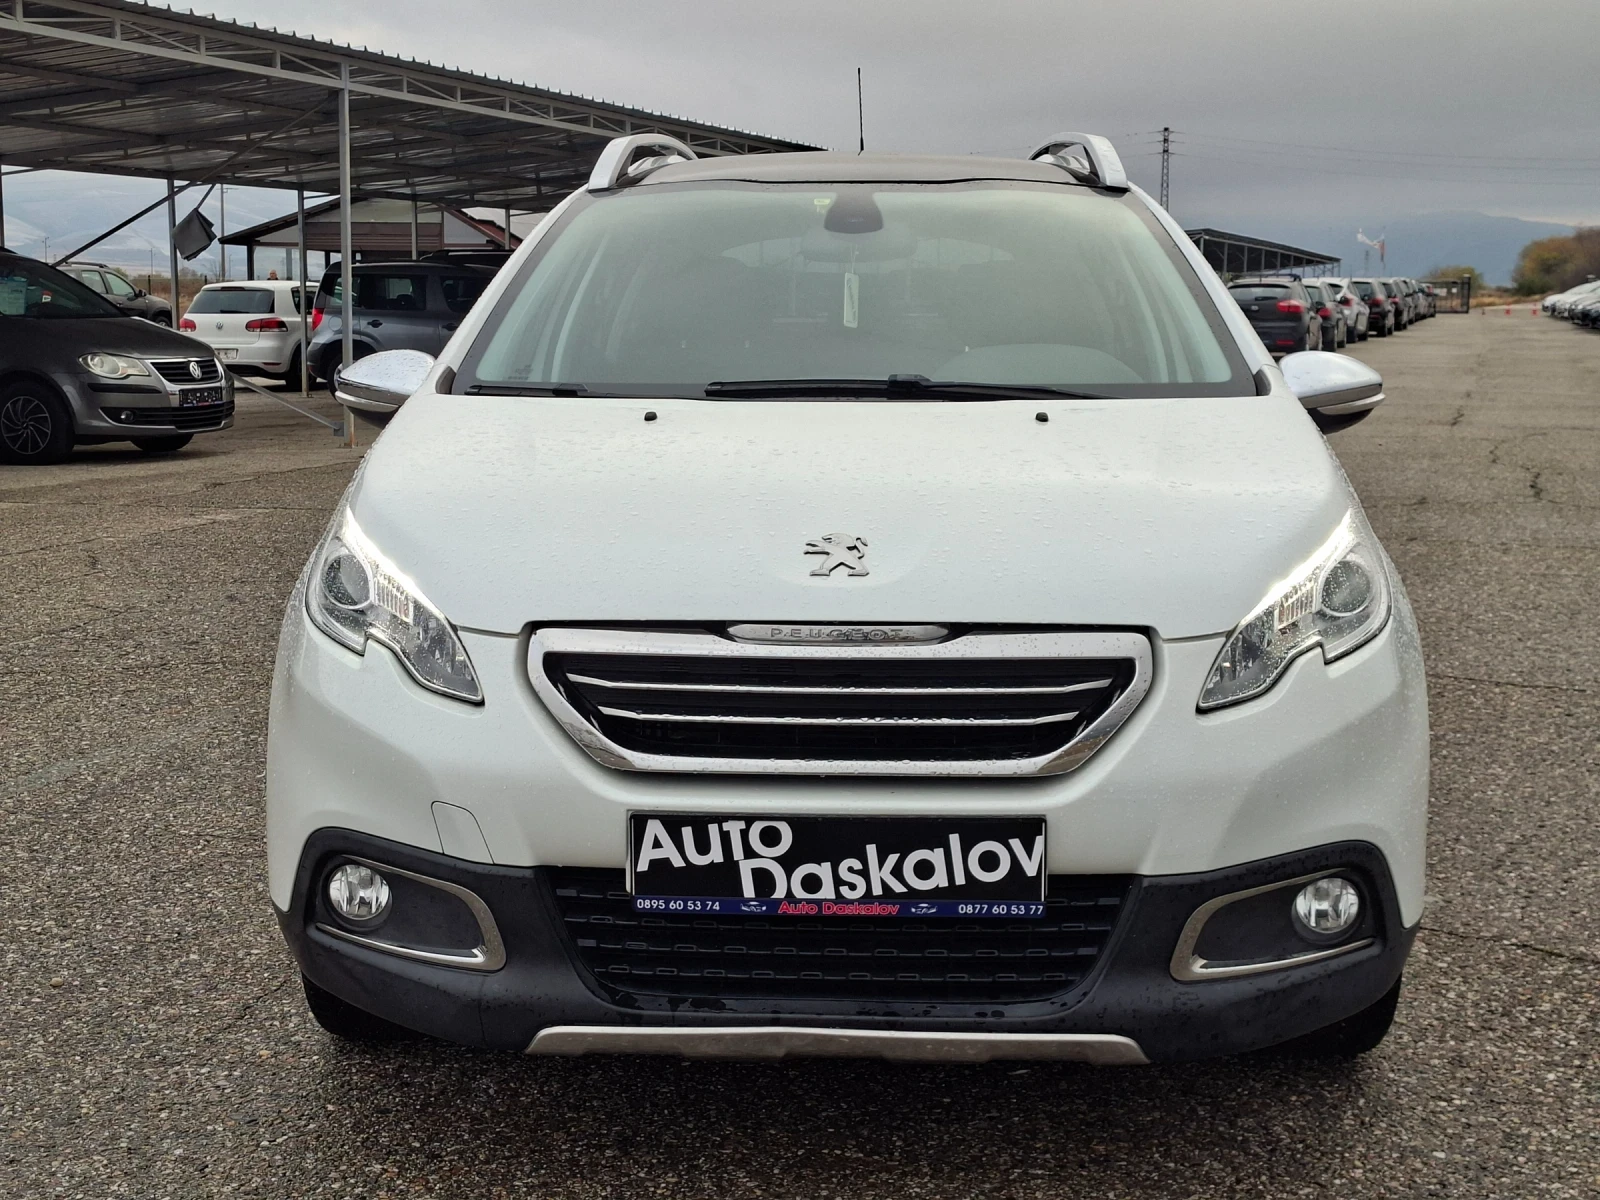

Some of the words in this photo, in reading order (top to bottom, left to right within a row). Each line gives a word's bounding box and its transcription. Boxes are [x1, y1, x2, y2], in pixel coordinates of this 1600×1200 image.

[770, 627, 904, 641] PEUGEOT
[636, 819, 793, 872] Auto
[738, 833, 1044, 900] Daskalov
[636, 899, 665, 910] 0895
[669, 900, 684, 911] 60
[687, 901, 702, 911] 53
[705, 901, 720, 911] 74
[778, 901, 818, 914] Auto
[822, 902, 900, 915] Daskalov
[958, 904, 988, 914] 0877
[991, 905, 1007, 915] 60
[1010, 905, 1026, 915] 53
[1029, 905, 1044, 915] 77
